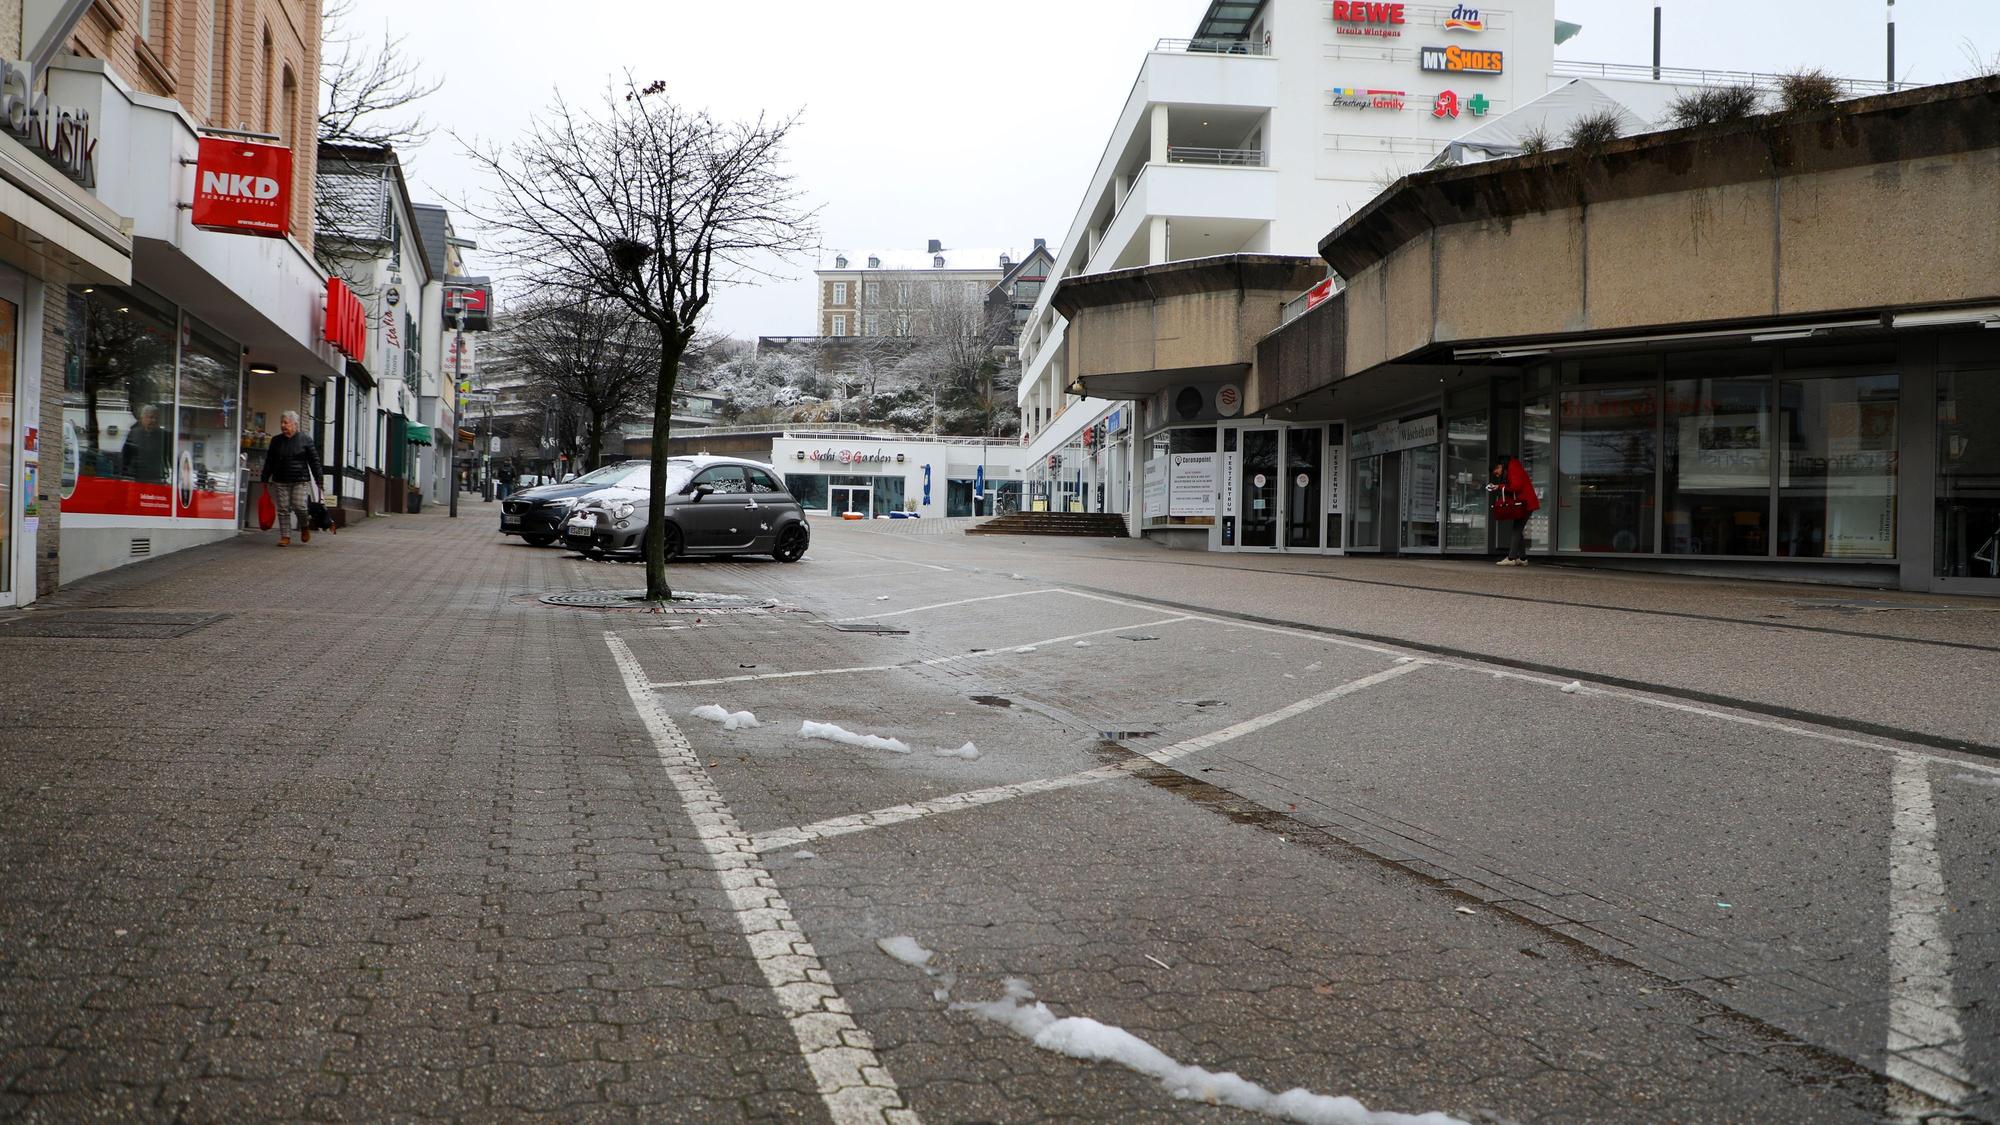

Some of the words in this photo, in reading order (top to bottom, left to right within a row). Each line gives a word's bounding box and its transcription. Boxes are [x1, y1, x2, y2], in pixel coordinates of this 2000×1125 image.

[1333, 0, 1405, 24] REWE
[1451, 4, 1479, 20] dm
[1336, 27, 1362, 36] Ursula
[1364, 28, 1400, 38] Wintgens
[1372, 97, 1404, 112] family
[202, 170, 279, 199] NKD
[330, 278, 366, 363] NKD
[383, 310, 400, 348] Italia
[810, 448, 836, 462] Sushi
[853, 448, 892, 464] Garden
[1183, 456, 1211, 464] Coronapoint
